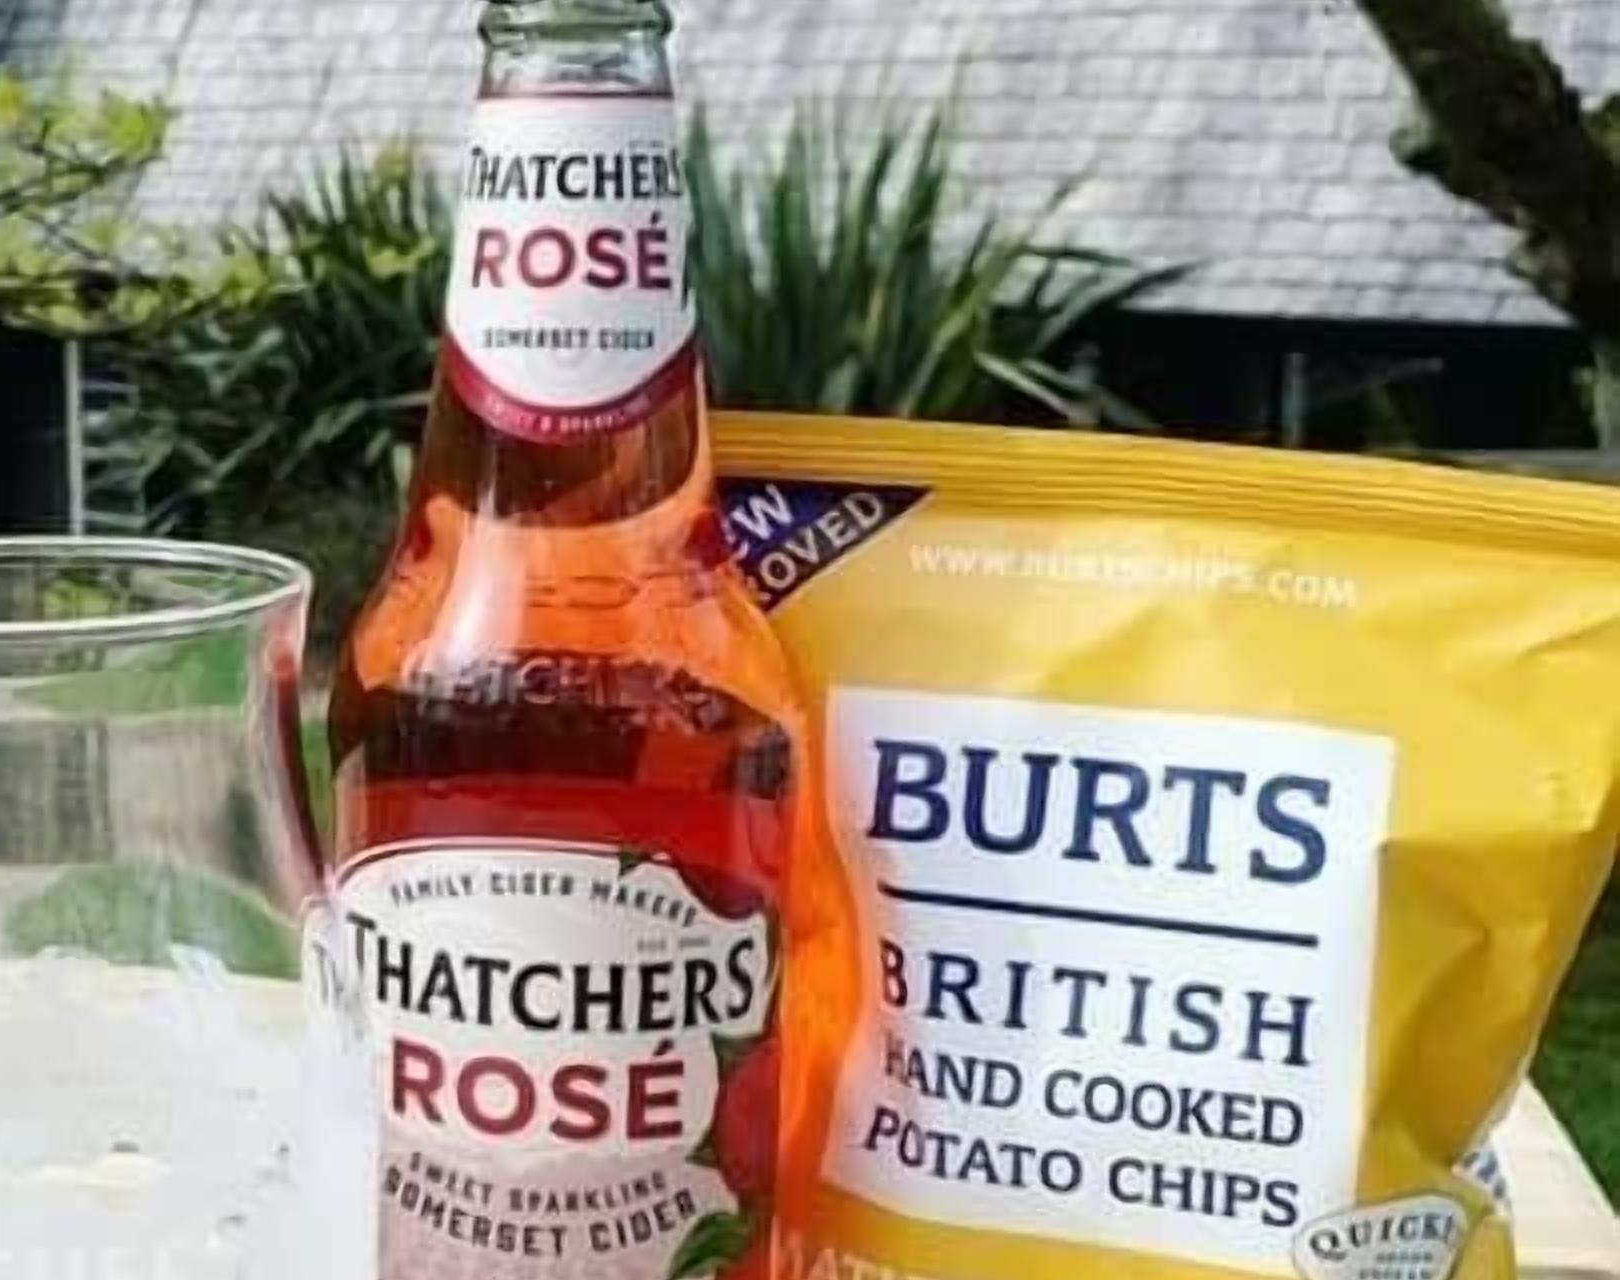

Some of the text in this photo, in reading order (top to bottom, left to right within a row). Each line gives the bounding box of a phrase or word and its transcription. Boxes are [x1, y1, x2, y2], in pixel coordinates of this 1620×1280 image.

[471, 212, 672, 290] ROSÉ
[867, 737, 1332, 886] BURTS
[391, 871, 697, 927] FAMILY CIDER MAKERS
[346, 910, 756, 1035] THATCHERS
[879, 939, 1315, 1068] BRITISH
[390, 1038, 685, 1142] ROSÉ
[883, 1035, 1305, 1148] HAND COOKED
[383, 1166, 698, 1257] SOMERSET CIDER
[409, 1151, 669, 1216] SWEET SPARKLING
[864, 1107, 1299, 1229] POTATO CHIPS
